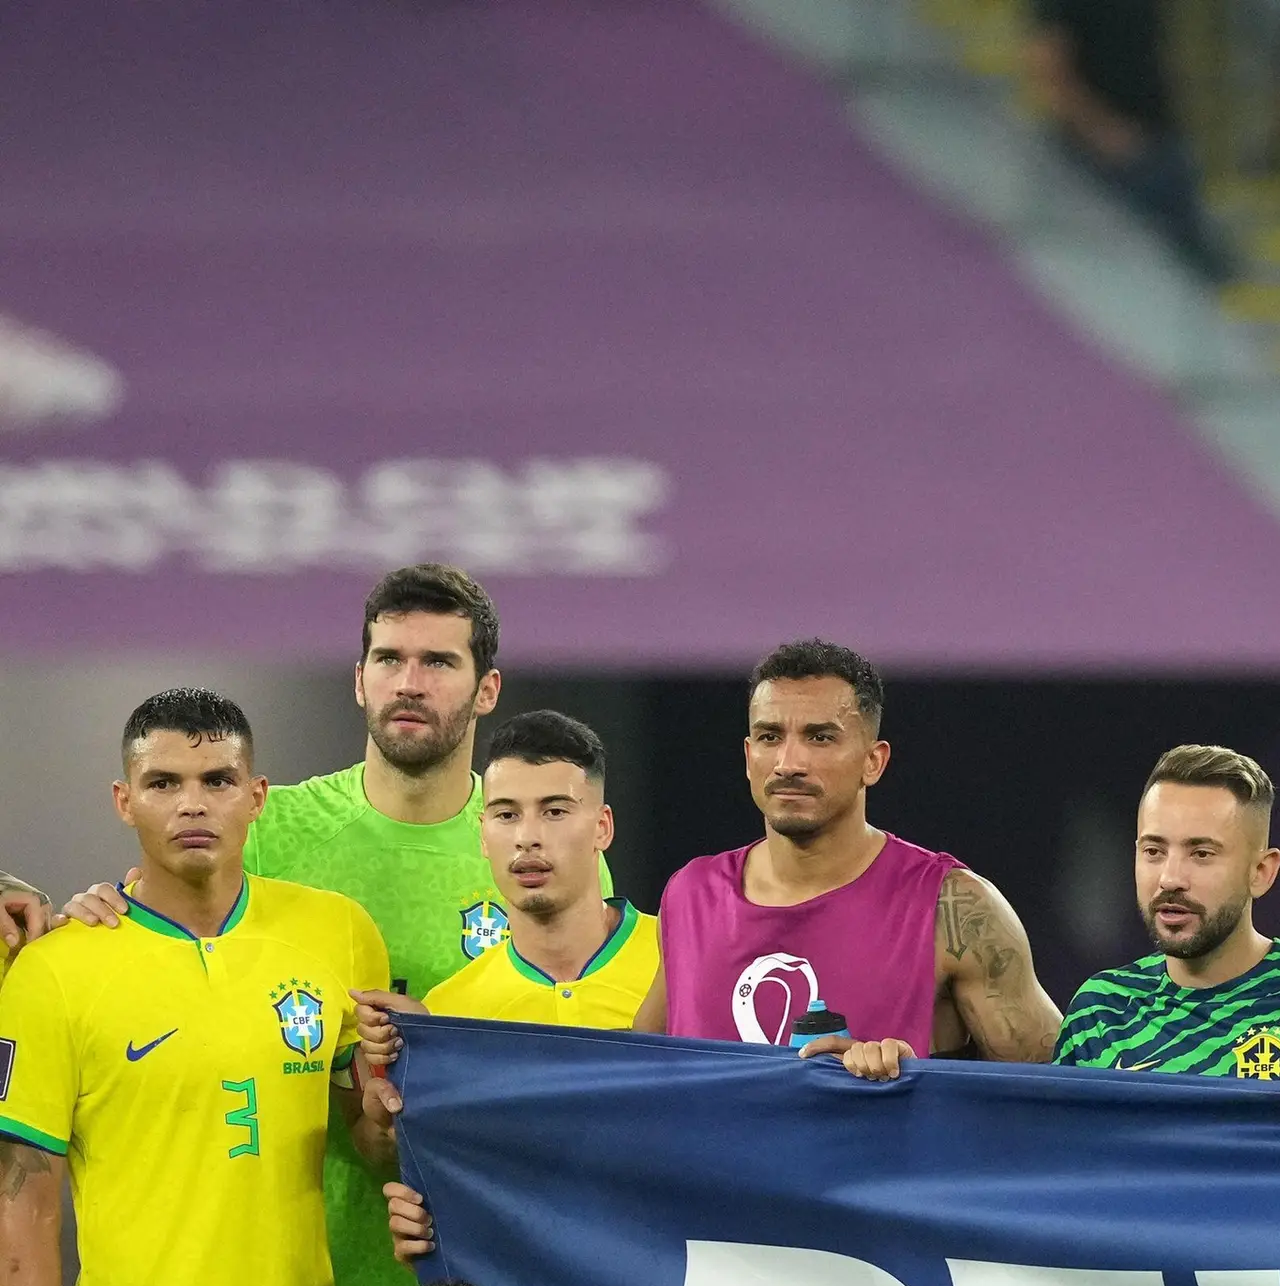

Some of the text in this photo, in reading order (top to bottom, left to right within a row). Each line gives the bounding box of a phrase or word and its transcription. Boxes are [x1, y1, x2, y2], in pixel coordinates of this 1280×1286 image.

[476, 927, 496, 938] CBF
[292, 1015, 311, 1025] CBF
[283, 1060, 325, 1075] BRASIL
[1254, 1064, 1274, 1073] CBF
[221, 1077, 260, 1160] 3
